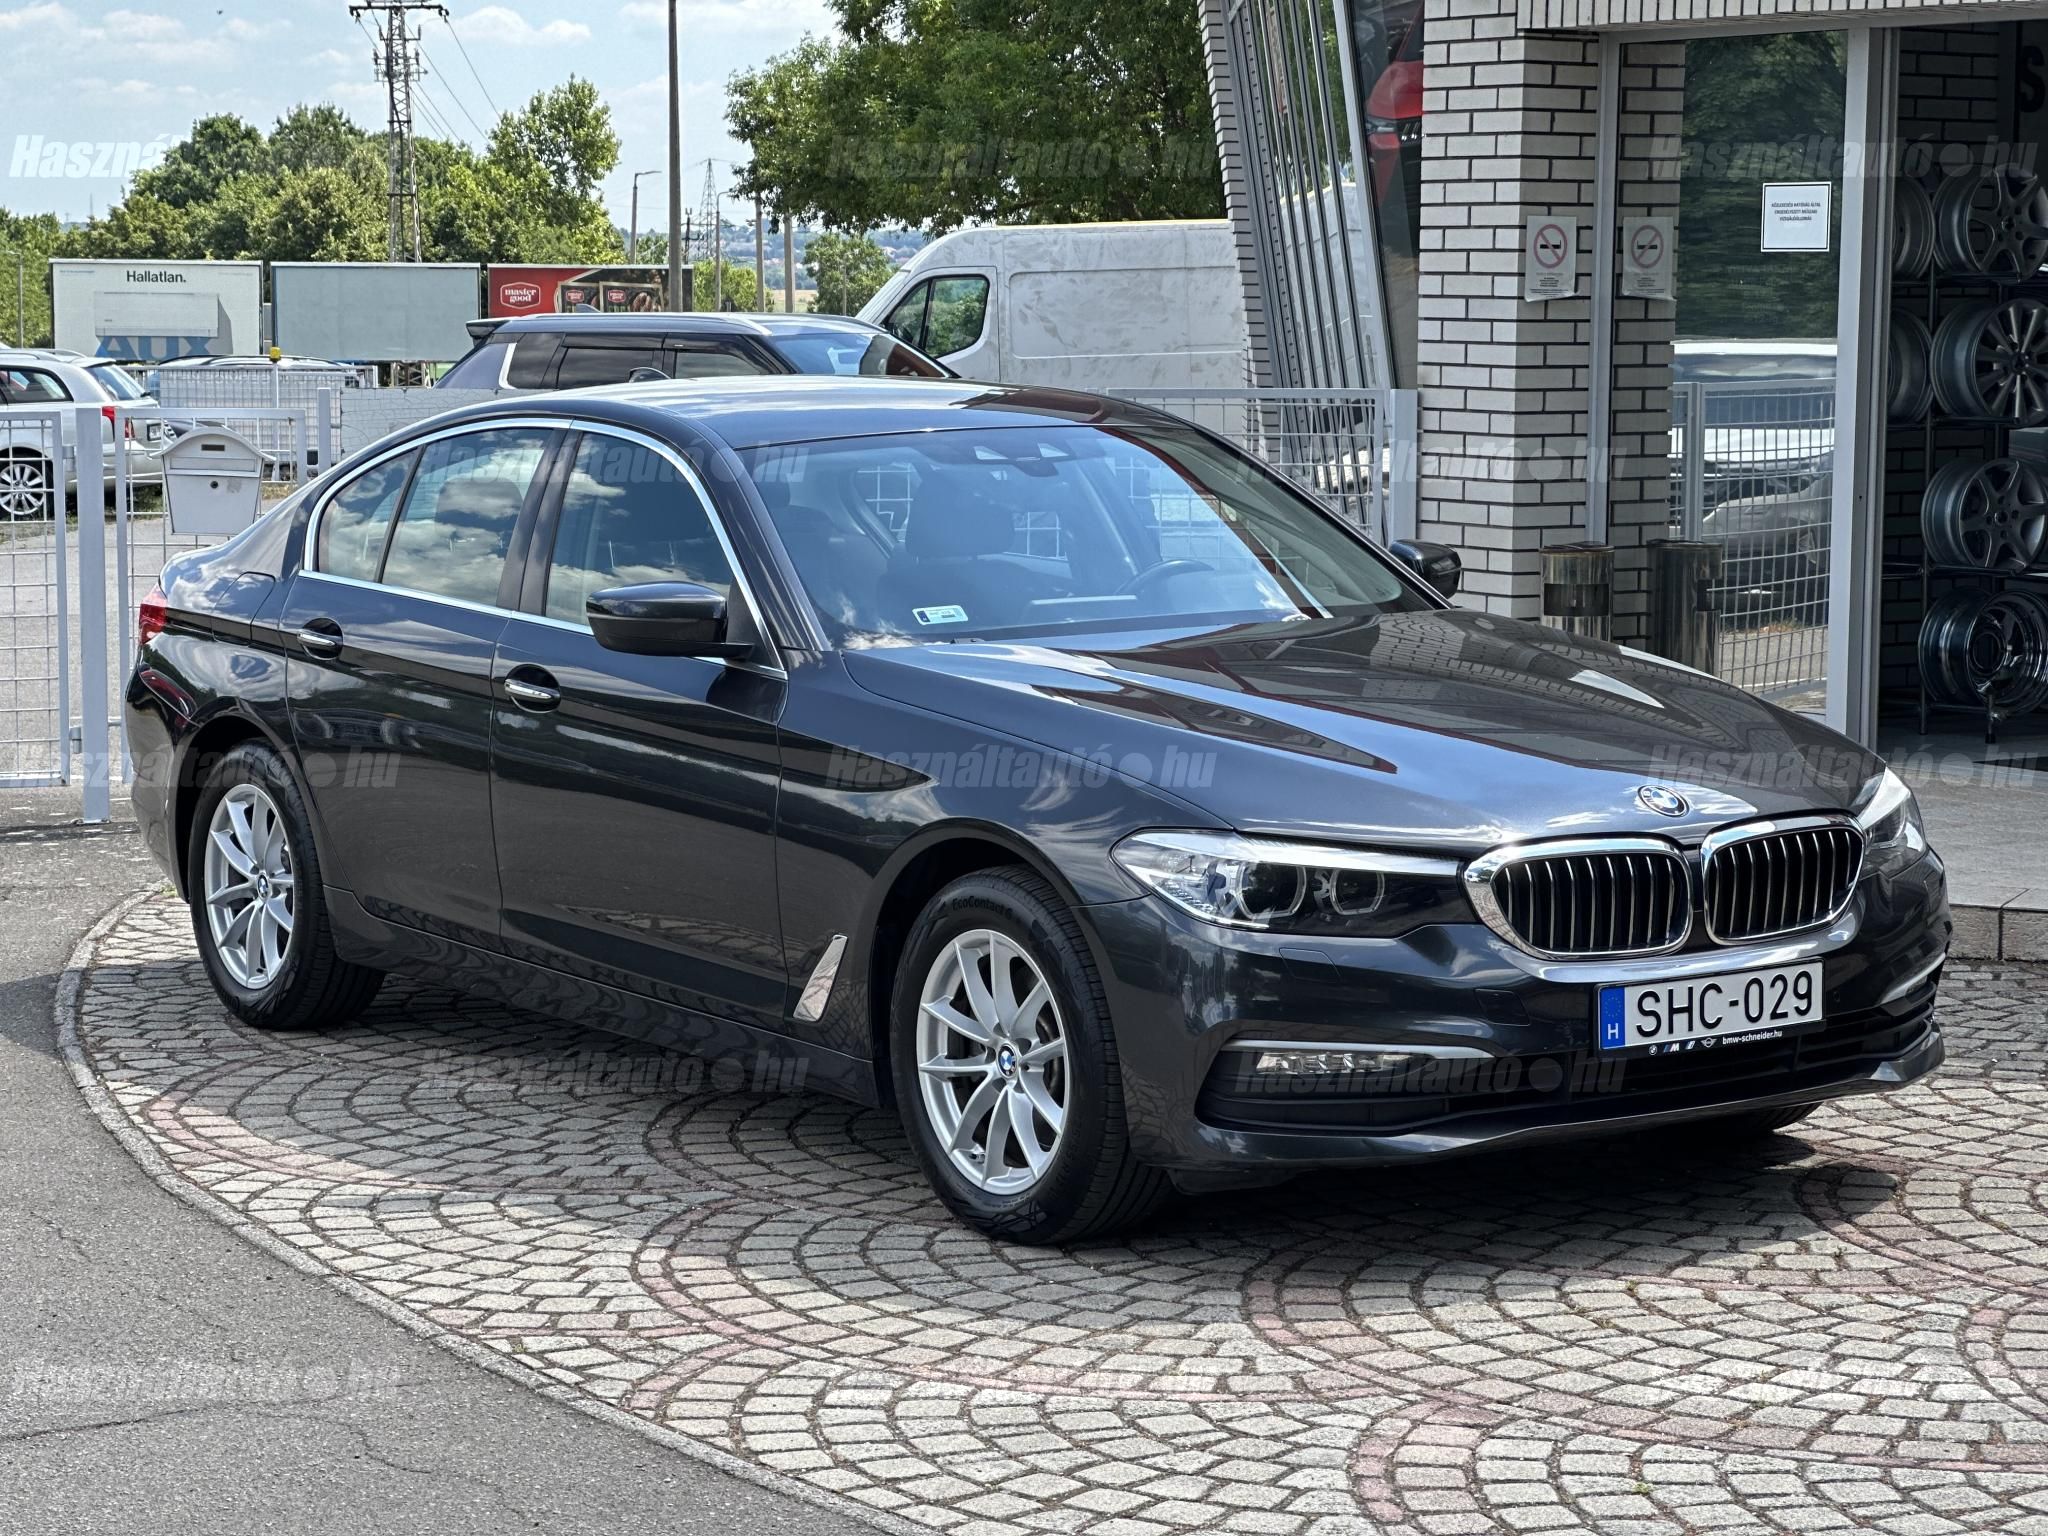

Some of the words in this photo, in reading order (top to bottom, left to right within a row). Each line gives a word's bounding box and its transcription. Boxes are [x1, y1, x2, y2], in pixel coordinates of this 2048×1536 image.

[126, 270, 187, 283] Hallatlan.
[504, 288, 537, 296] master
[509, 294, 532, 303] good
[94, 336, 212, 361] AUX
[1636, 970, 1813, 1038] SHC-029
[1607, 1023, 1619, 1040] H
[1722, 1030, 1783, 1046] bmw-schneider.hu
